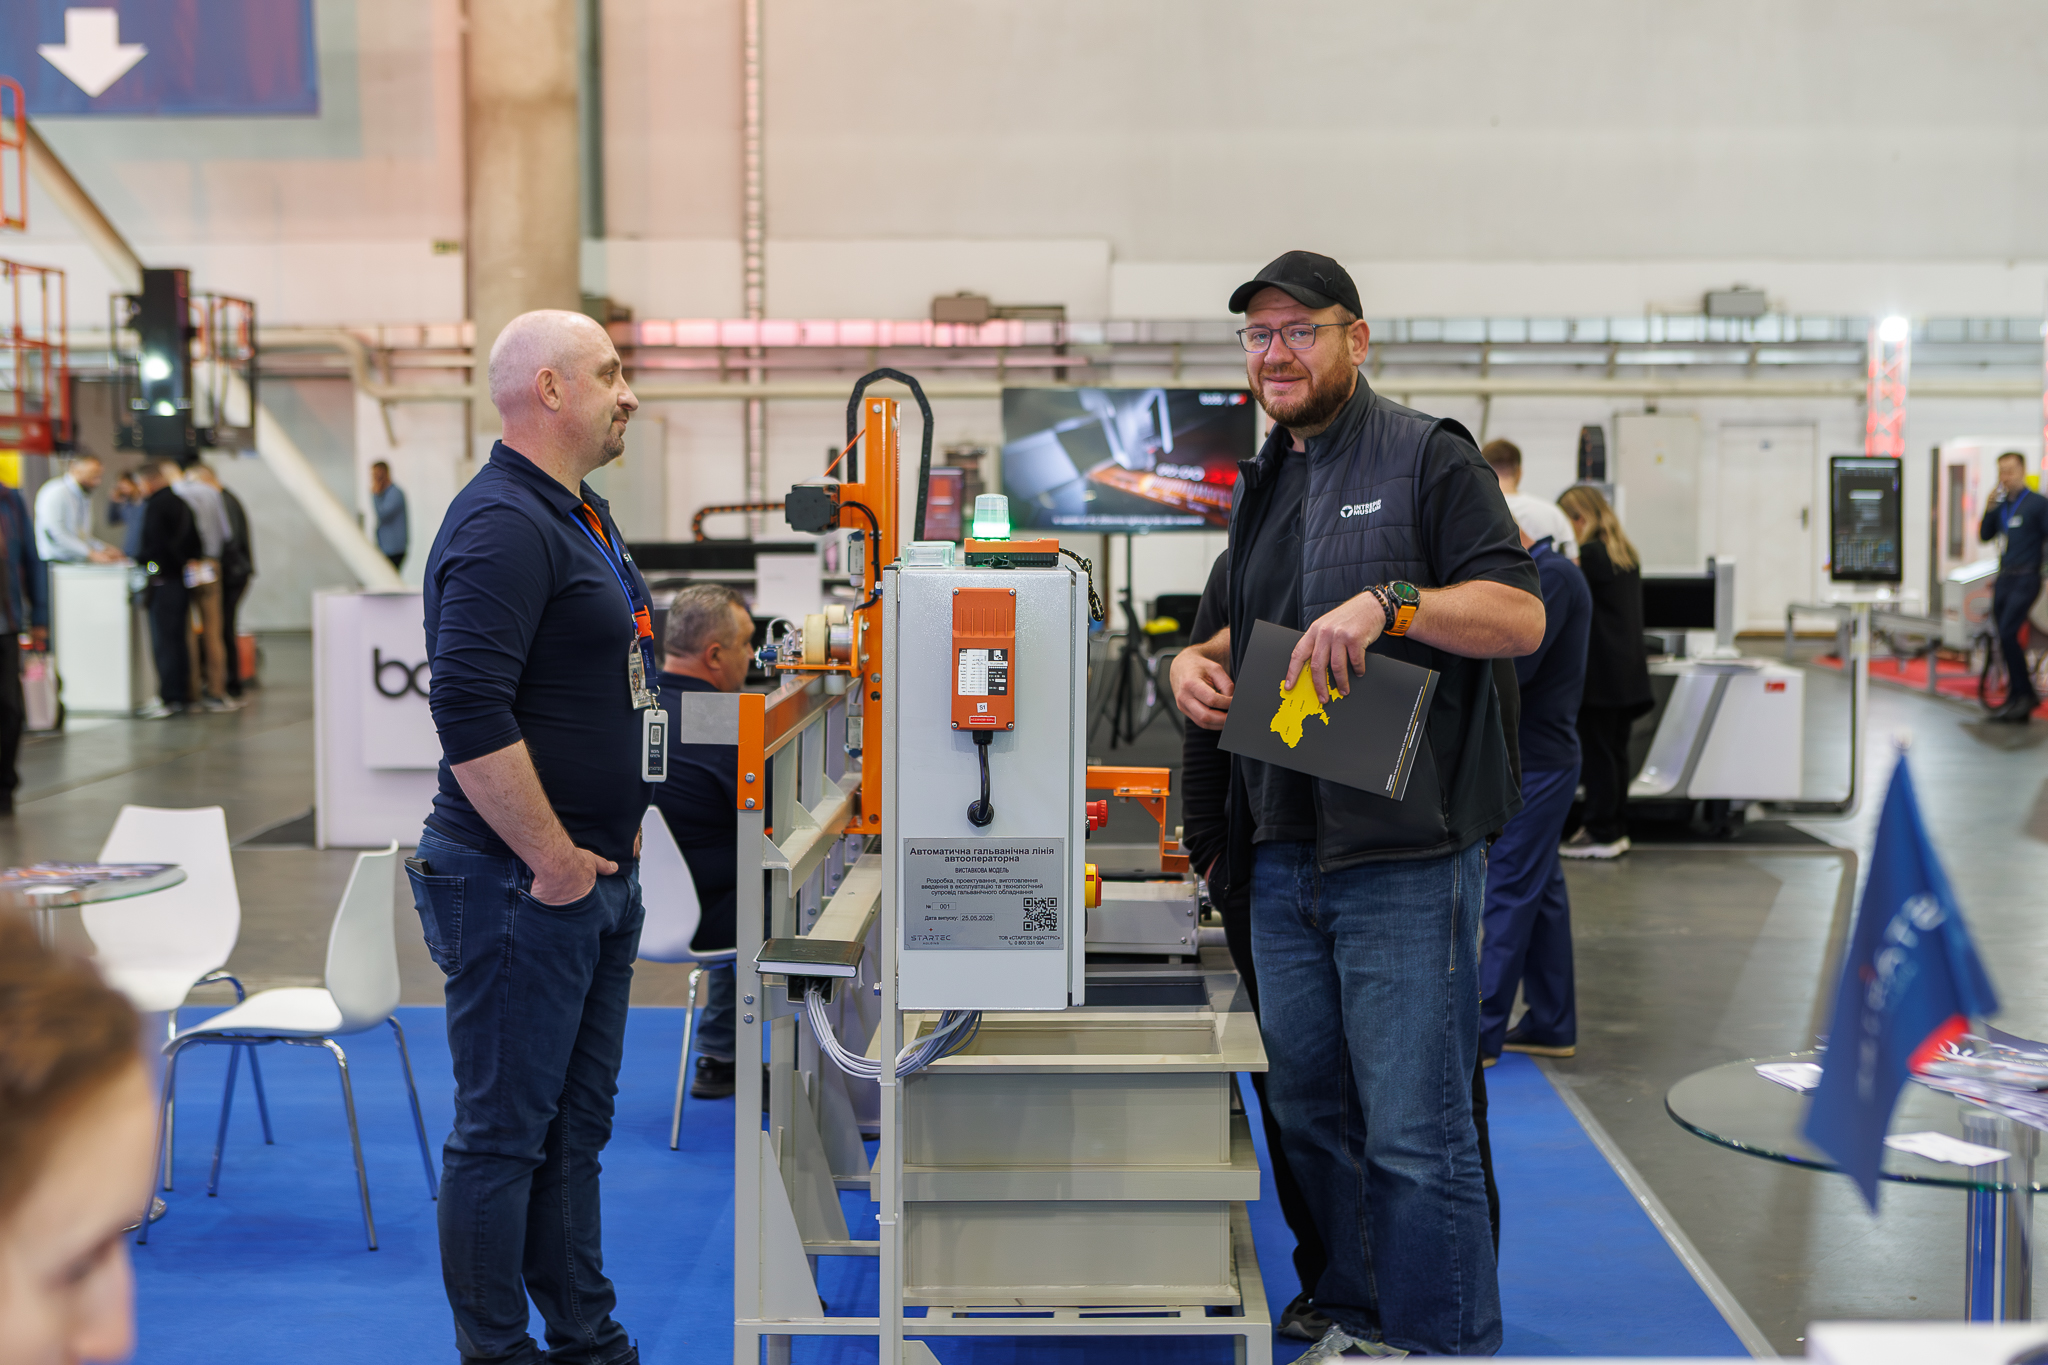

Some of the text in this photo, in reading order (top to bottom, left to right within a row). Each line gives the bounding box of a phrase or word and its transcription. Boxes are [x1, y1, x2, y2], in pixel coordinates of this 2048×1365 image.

[1353, 499, 1382, 511] INTREPID
[1353, 504, 1381, 516] MUSEUM
[910, 846, 1055, 856] Автоматична гальванічна лінія
[944, 855, 1020, 863] автооператорна
